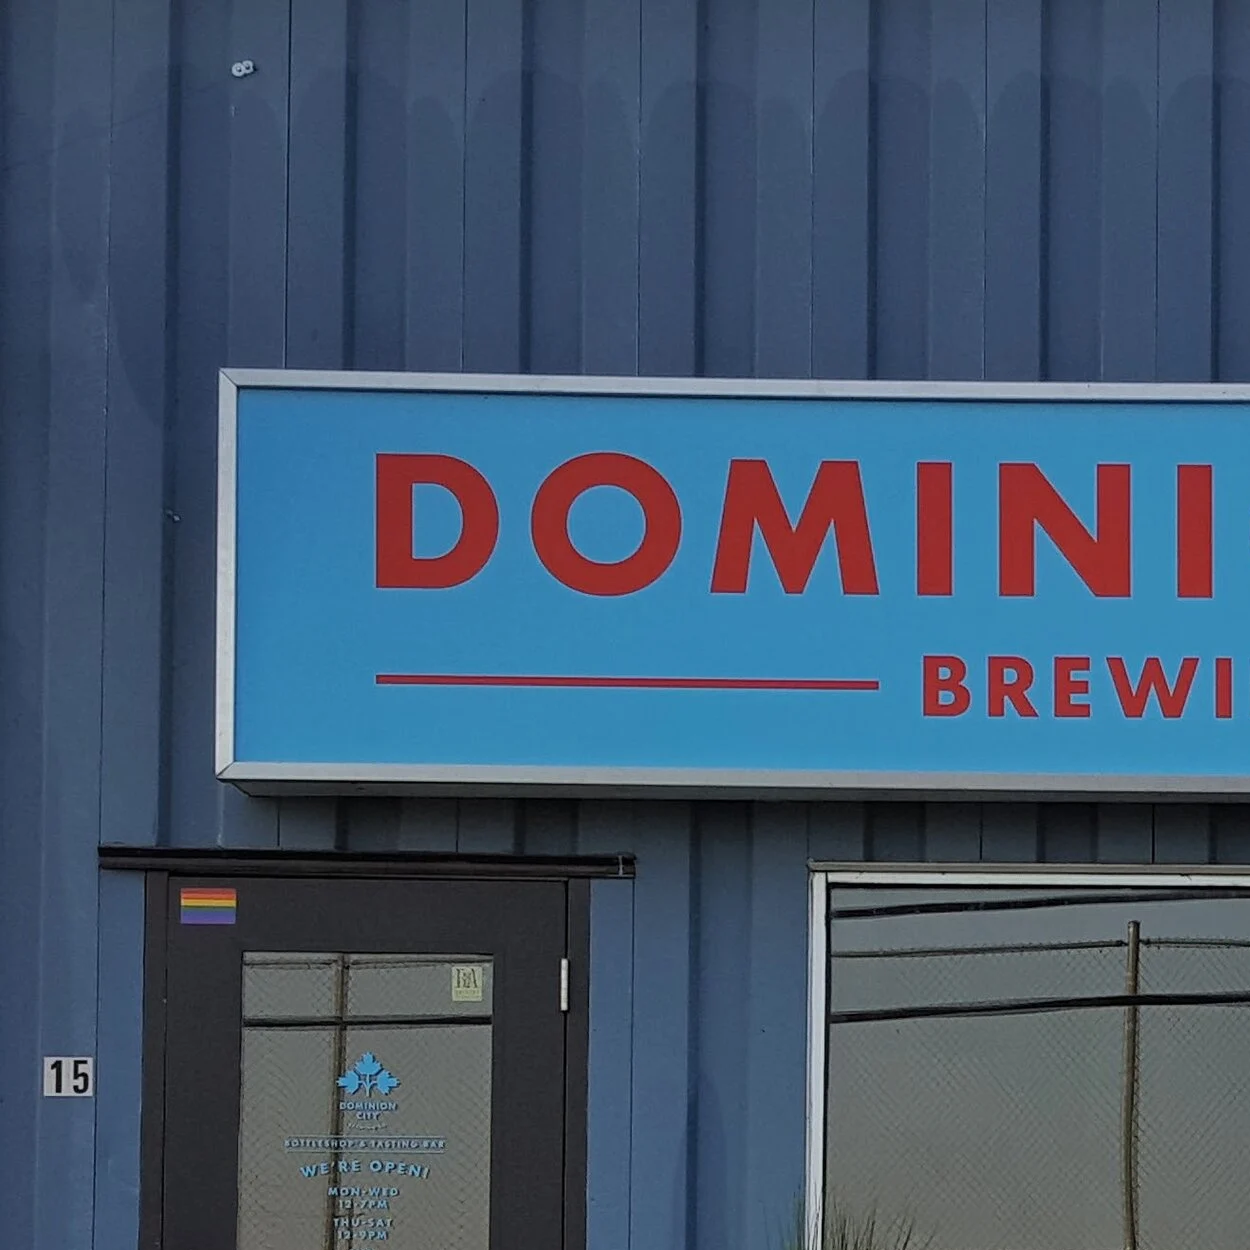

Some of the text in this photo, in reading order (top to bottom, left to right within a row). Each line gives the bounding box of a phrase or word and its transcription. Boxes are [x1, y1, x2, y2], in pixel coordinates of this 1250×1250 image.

[51, 1060, 89, 1094] 15
[339, 1101, 398, 1111] DOMINION
[356, 1111, 381, 1120] CITY
[284, 1138, 353, 1148] BOTTLESHOP
[371, 1139, 418, 1148] TASTING
[423, 1139, 444, 1148] BAR
[300, 1160, 430, 1179] WE'RE OPEN!
[327, 1187, 400, 1197] MON-WED
[334, 1218, 393, 1228] THU-SAT
